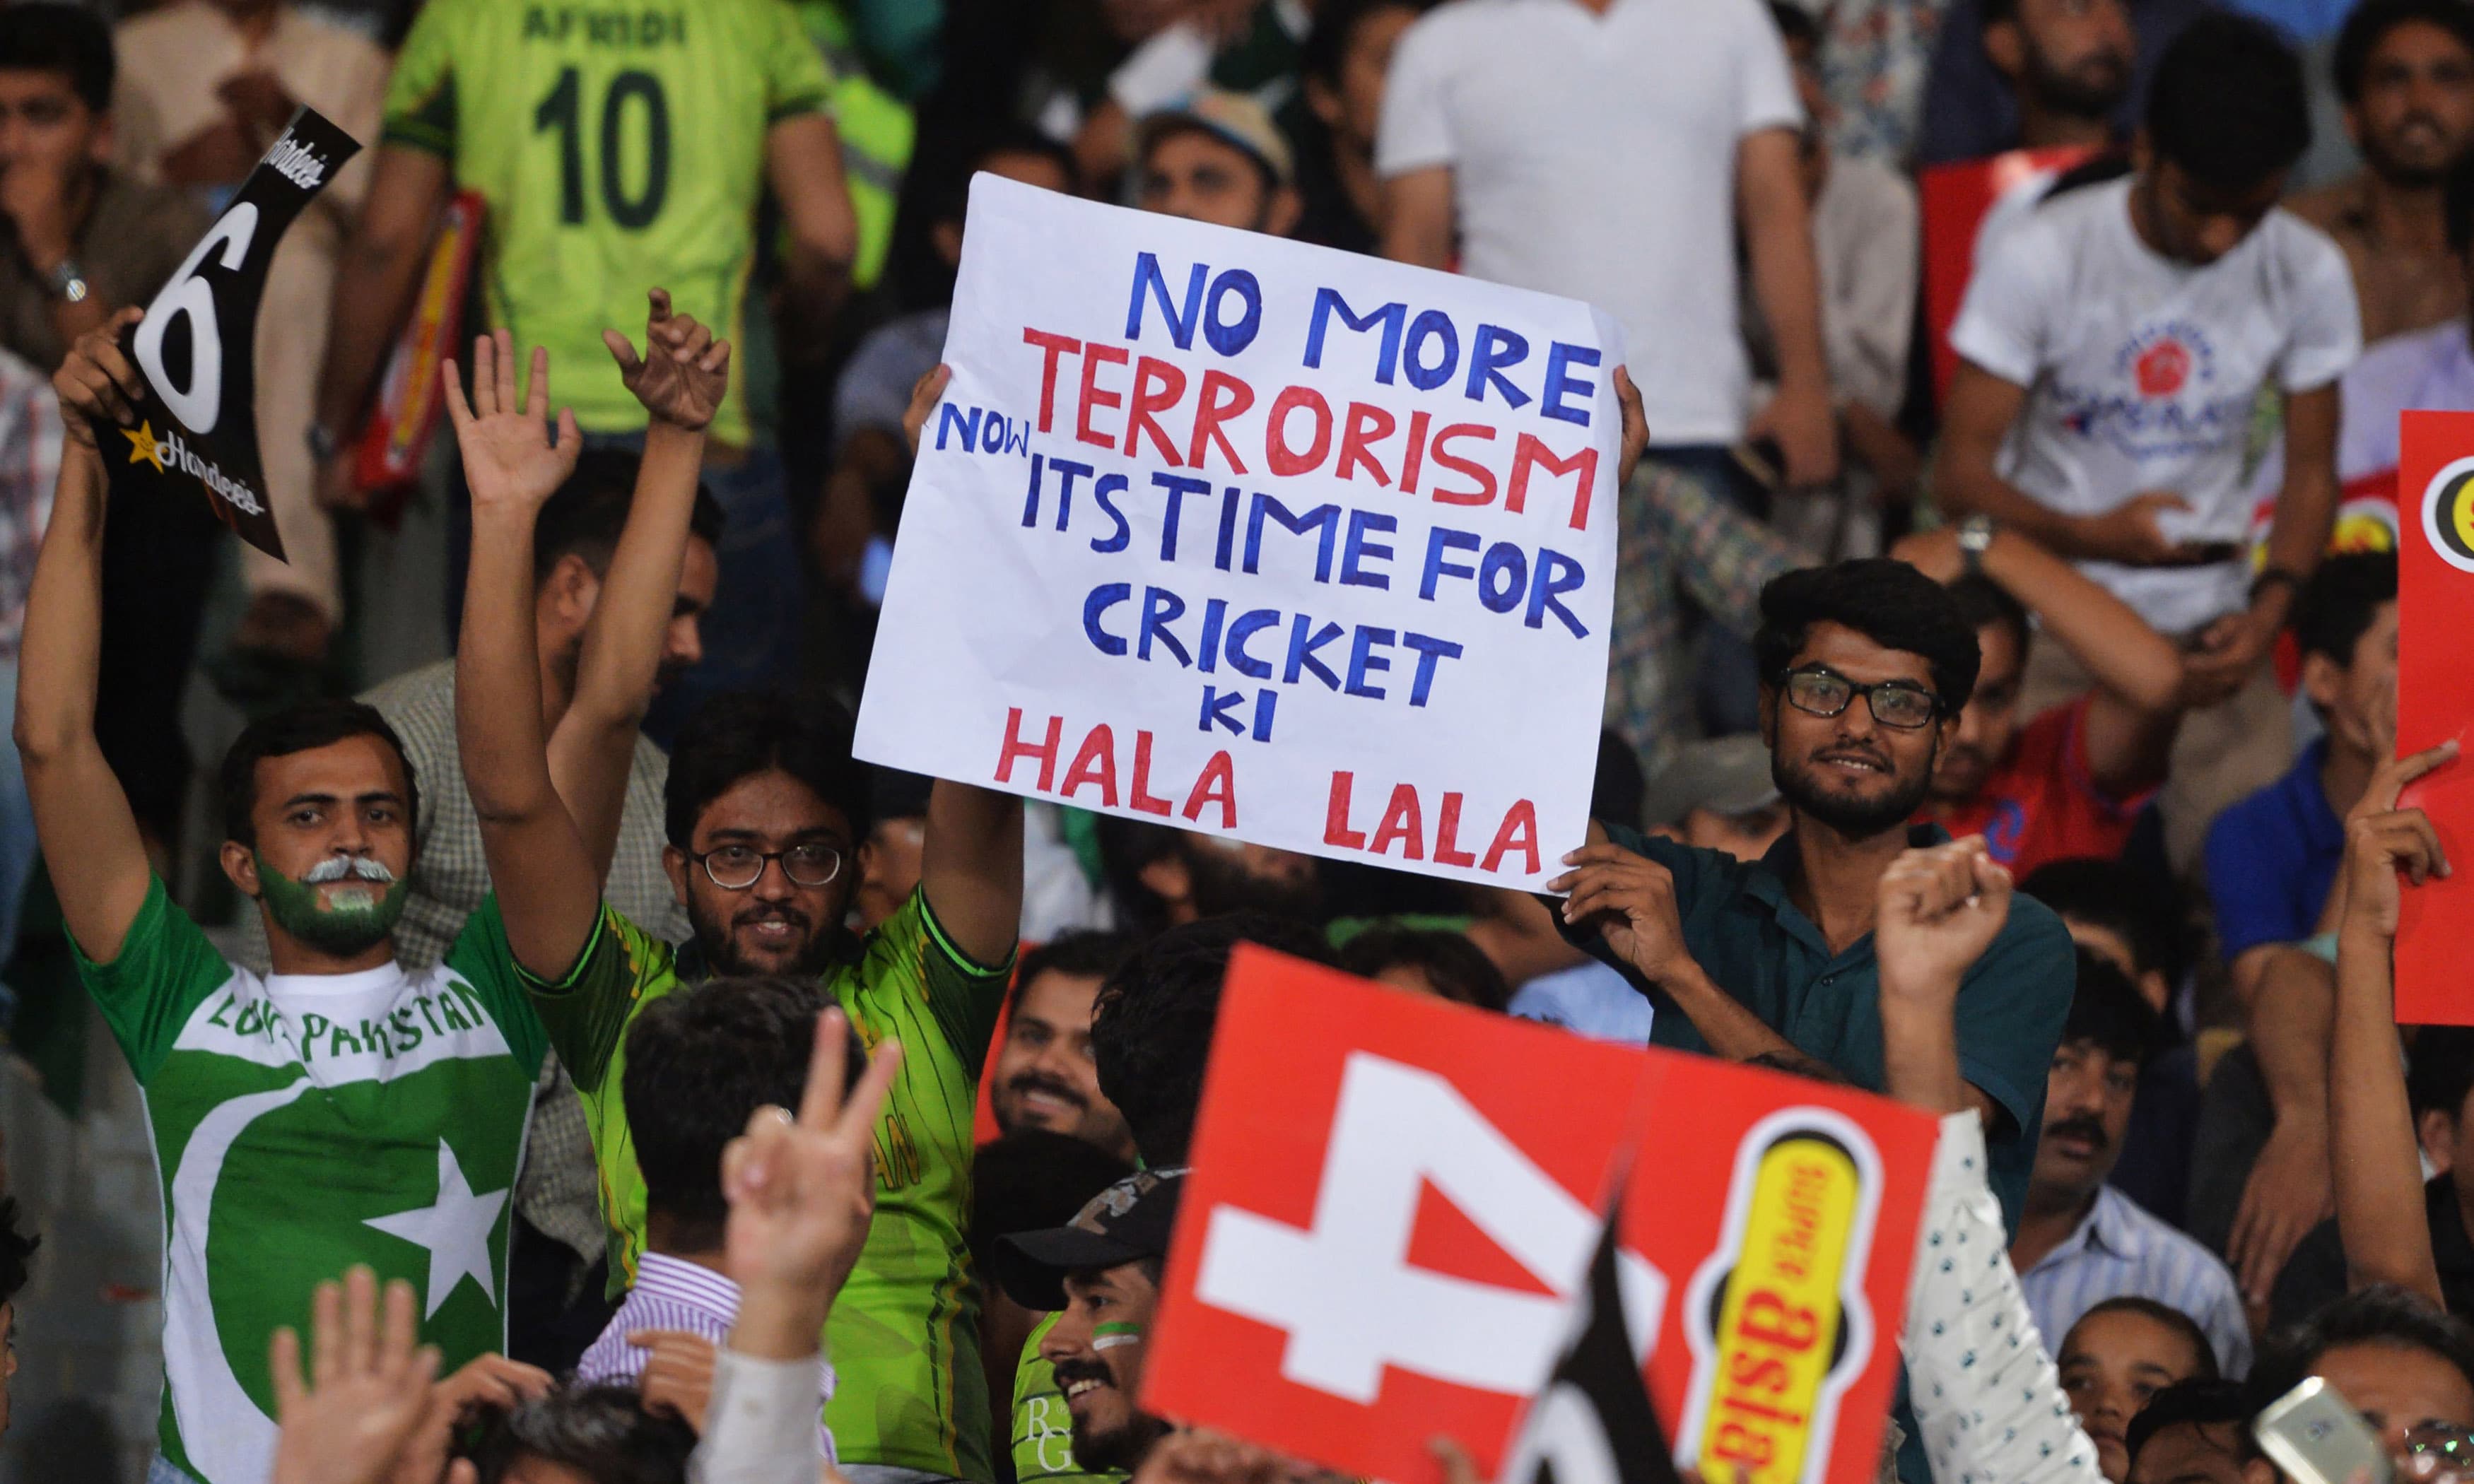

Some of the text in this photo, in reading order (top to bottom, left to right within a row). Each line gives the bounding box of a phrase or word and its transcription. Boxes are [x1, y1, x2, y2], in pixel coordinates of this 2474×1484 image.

[534, 68, 674, 230] 10
[133, 201, 259, 434] 6
[1125, 252, 1602, 428] NO MORE
[1023, 327, 1598, 531] TERRORISM
[935, 402, 1589, 639] NOW ITS TIME FOR
[1082, 582, 1464, 707] CRICKET
[1199, 685, 1278, 743] KI
[994, 707, 1541, 873] HALA LALA
[207, 991, 291, 1044] LOV
[1195, 1049, 1668, 1405] 4
